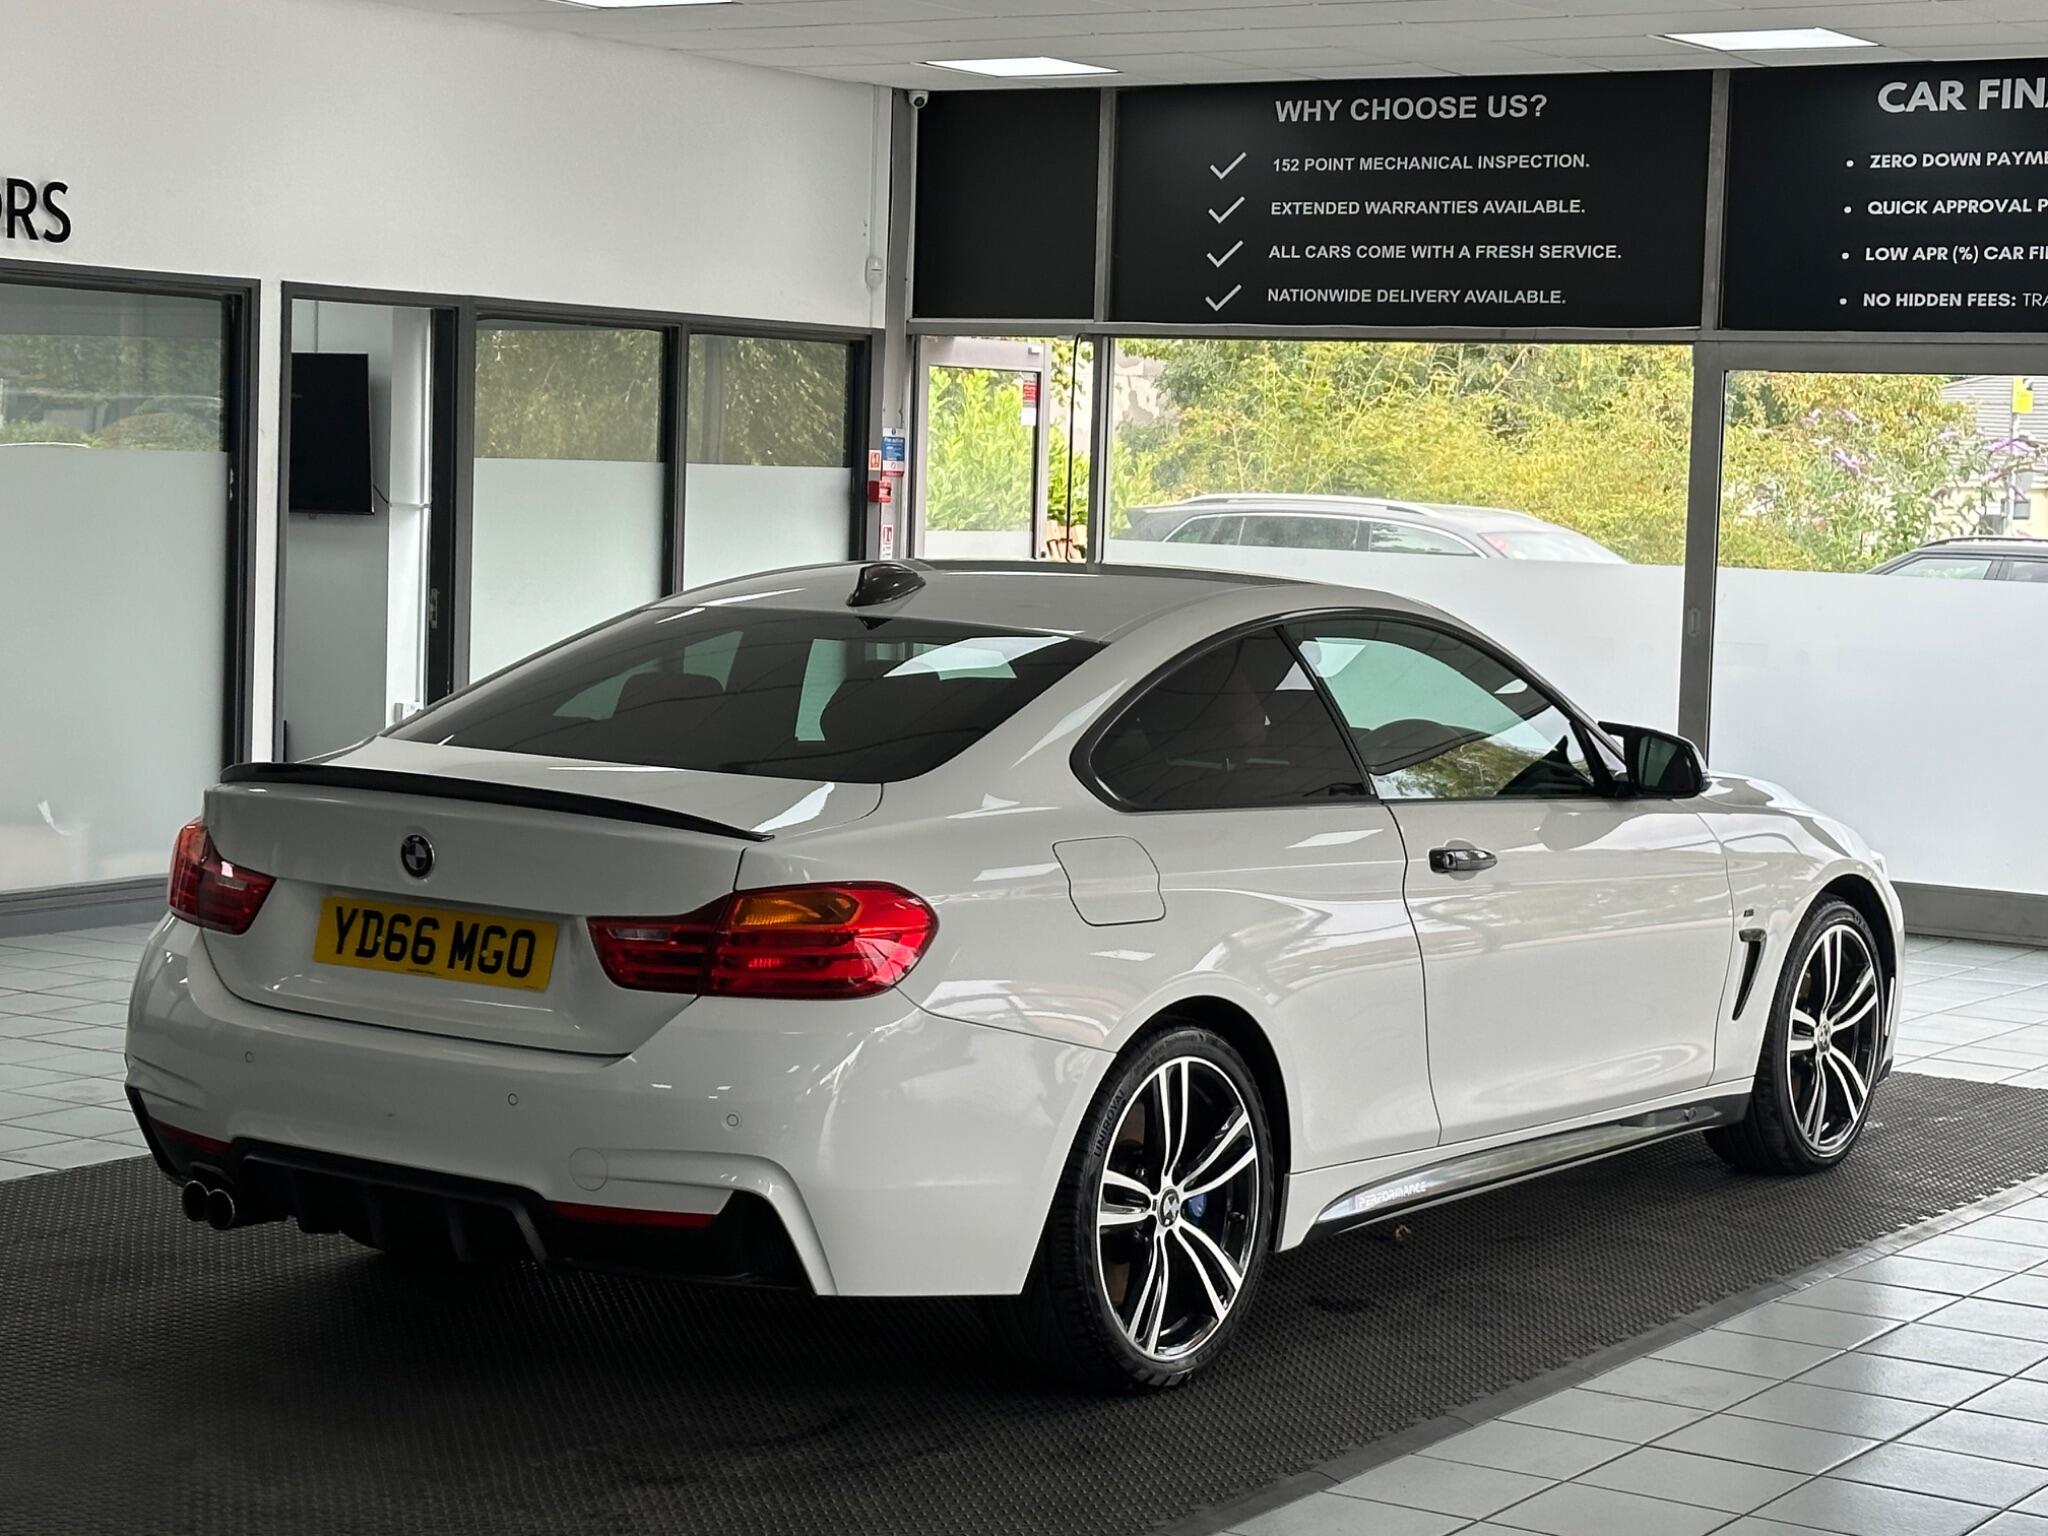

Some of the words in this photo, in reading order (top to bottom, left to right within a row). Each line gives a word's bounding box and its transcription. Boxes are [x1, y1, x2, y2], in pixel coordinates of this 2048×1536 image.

[1877, 80, 1968, 114] CAR
[1978, 76, 2048, 111] FIN
[1275, 99, 1343, 123] WHY
[1350, 95, 1478, 122] CHOOSE
[1487, 94, 1548, 118] US?
[1272, 157, 1300, 173] 152
[1304, 157, 1356, 172] POINT
[1358, 154, 1473, 172] MECHANICAL
[1477, 153, 1591, 170] INSPECTION.
[1869, 153, 1918, 169] ZERO
[1922, 151, 1982, 168] DOWN
[0, 178, 71, 243] RS
[1270, 201, 1360, 216] EXTENDED
[1364, 200, 1479, 216] WARRANTIES
[1482, 199, 1586, 215] AVAILABLE.
[1867, 199, 1929, 215] QUICK
[1931, 198, 2033, 215] APPROVAL
[1268, 245, 1301, 260] ALL
[1304, 244, 1352, 260] CARS
[1356, 244, 1407, 260] COME
[1410, 244, 1455, 260] WITH
[1458, 244, 1471, 259] A
[1475, 244, 1534, 259] FRESH
[1539, 244, 1622, 260] SERVICE.
[1865, 246, 1909, 261] LOW
[1911, 246, 1949, 261] APR
[1952, 244, 1979, 265] (%)
[1983, 246, 2025, 261] CAR
[2028, 245, 2048, 260] FI
[1267, 287, 1372, 304] NATIONWIDE
[1376, 288, 1461, 304] DELIVERY
[1463, 289, 1567, 305] AVAILABLE.
[1863, 292, 1892, 307] NO
[1895, 292, 1962, 307] HIDDEN
[1967, 292, 2017, 307] FEES:
[335, 906, 440, 966] YD66
[447, 920, 536, 978] MGO
